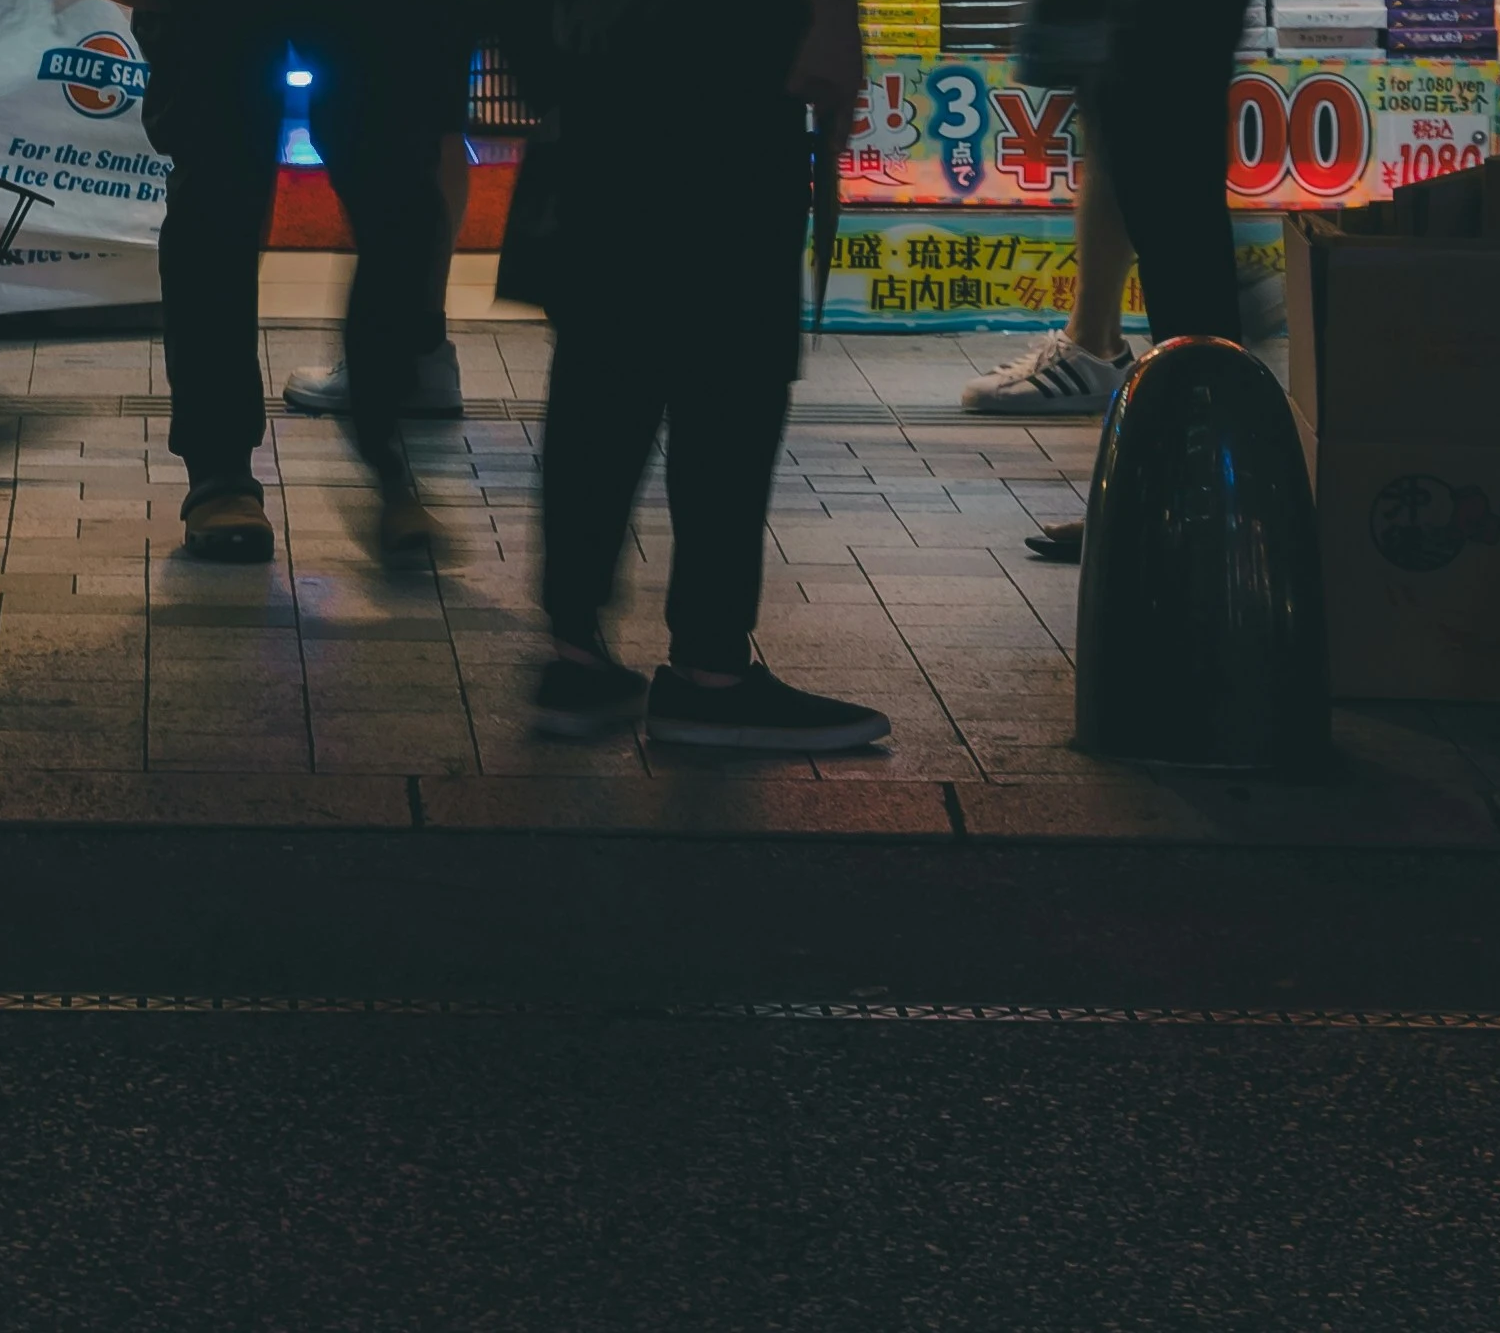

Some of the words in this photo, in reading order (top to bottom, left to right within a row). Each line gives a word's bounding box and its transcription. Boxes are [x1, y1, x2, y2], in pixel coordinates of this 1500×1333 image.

[48, 52, 103, 80] BLUE
[110, 62, 151, 89] SEA
[1376, 76, 1387, 93] 3
[1390, 76, 1412, 93] for
[1416, 76, 1455, 93] 1080
[1458, 79, 1487, 99] yen
[1412, 118, 1455, 140] 税込
[8, 137, 51, 161] For
[54, 144, 89, 167] the
[94, 150, 173, 179] Smiles
[13, 165, 49, 188] Ice
[53, 171, 132, 200] Cream
